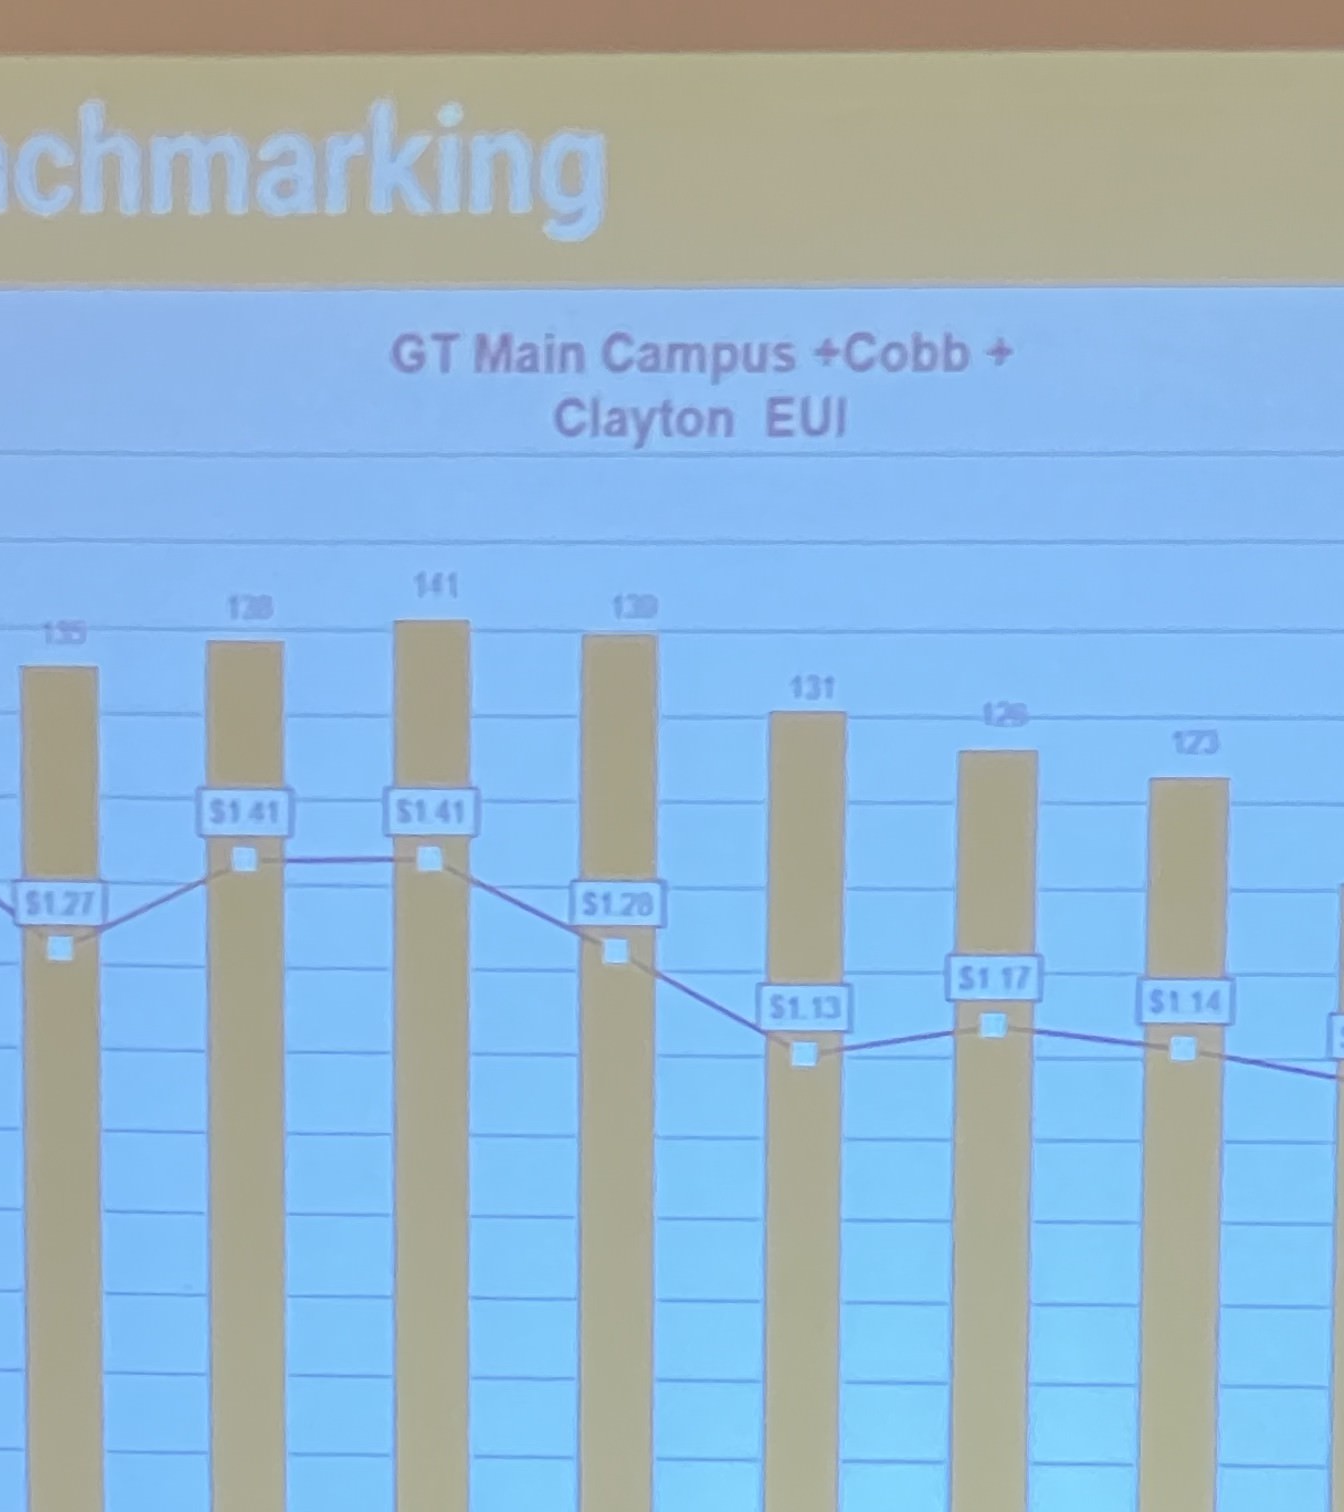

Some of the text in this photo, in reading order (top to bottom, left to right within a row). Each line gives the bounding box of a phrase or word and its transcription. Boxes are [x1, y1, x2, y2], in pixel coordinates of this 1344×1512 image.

[389, 332, 460, 375] GT
[472, 332, 587, 375] Main
[600, 331, 796, 385] Campus
[552, 396, 849, 449] Clayton EUI
[414, 572, 457, 598] 141
[791, 675, 834, 699] 131
[397, 798, 464, 823] $1.41
[25, 890, 95, 916] $1.27
[770, 994, 841, 1019] $1.13
